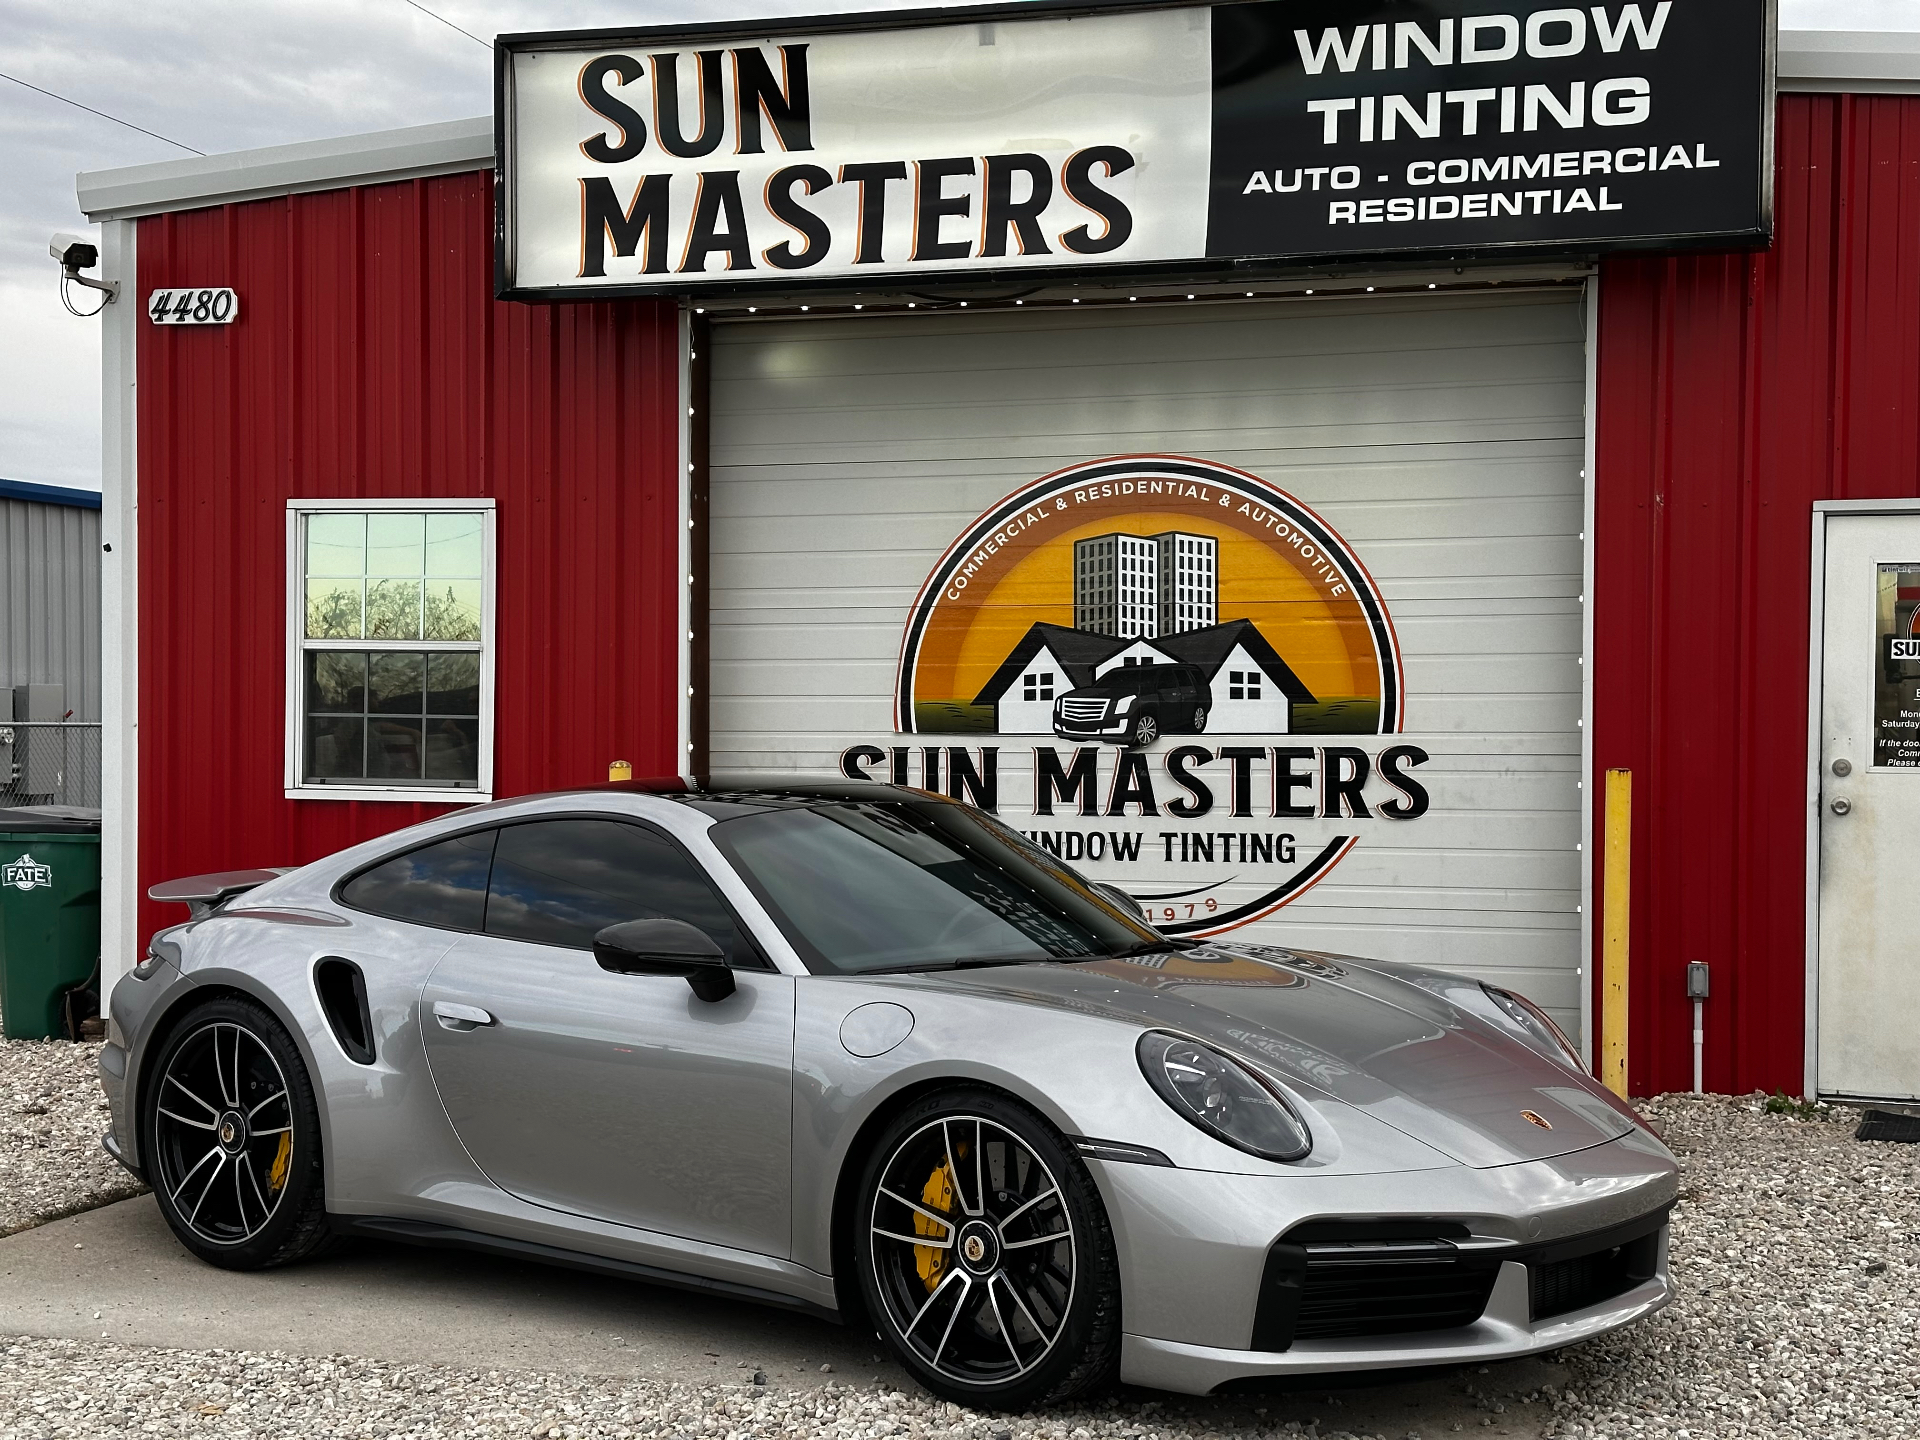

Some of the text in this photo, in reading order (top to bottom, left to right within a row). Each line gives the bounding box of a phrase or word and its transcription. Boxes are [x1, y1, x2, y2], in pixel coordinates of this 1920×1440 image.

[1293, 1, 1672, 76] WINDOW
[576, 43, 815, 164] SUN
[1306, 77, 1651, 145] TINTING
[1242, 165, 1361, 195] AUTO
[1406, 143, 1720, 186] COMMERCIAL
[576, 145, 1136, 278] MASTERS
[1328, 187, 1623, 225] RESIDENTIAL
[150, 289, 232, 323] 4480
[947, 480, 1347, 601] COMMERCIAL & RESIDENTIAL & AUTOMOTIVE
[1893, 641, 1920, 657] SU
[1881, 719, 1920, 730] Saturday
[1900, 710, 1920, 718] Mon
[1879, 739, 1920, 747] If the doo
[1887, 758, 1916, 767] Please
[1031, 744, 1431, 820] MASTERS
[1019, 830, 1297, 864] NDOW TINTING
[7, 867, 46, 882] FATE
[1145, 897, 1218, 923] 1979
